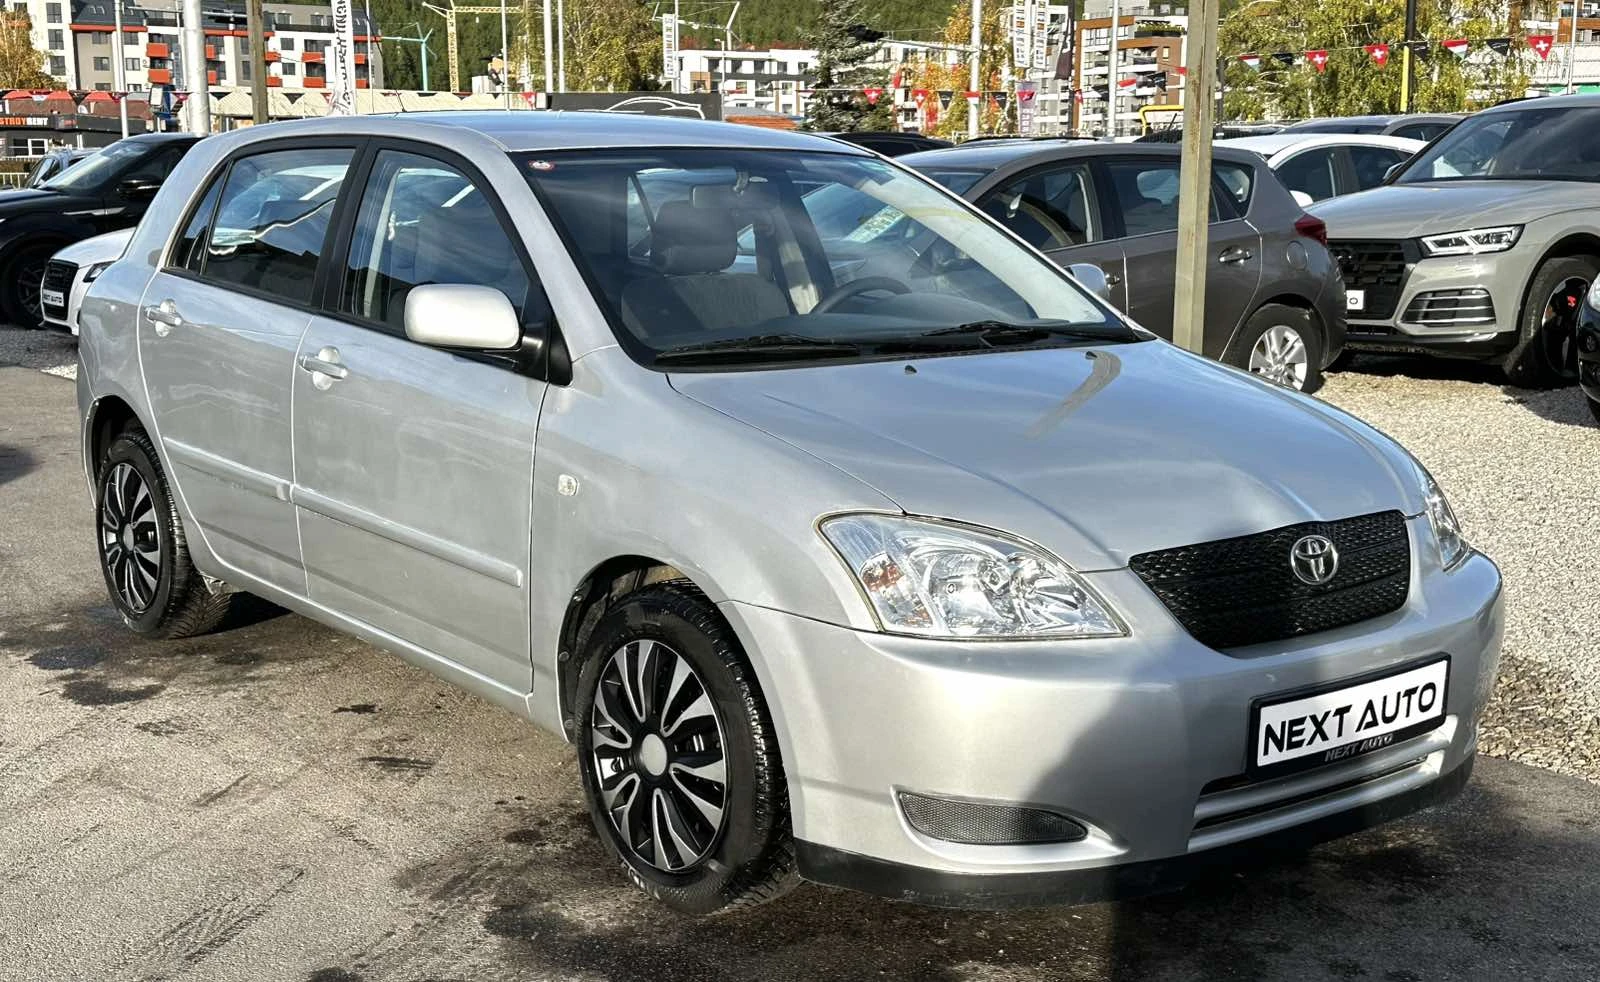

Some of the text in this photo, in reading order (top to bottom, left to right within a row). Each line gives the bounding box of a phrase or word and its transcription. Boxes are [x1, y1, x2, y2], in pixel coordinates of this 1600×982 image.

[1263, 682, 1437, 756] NEXT AUTO
[1324, 733, 1393, 762] NEXT AUTO
